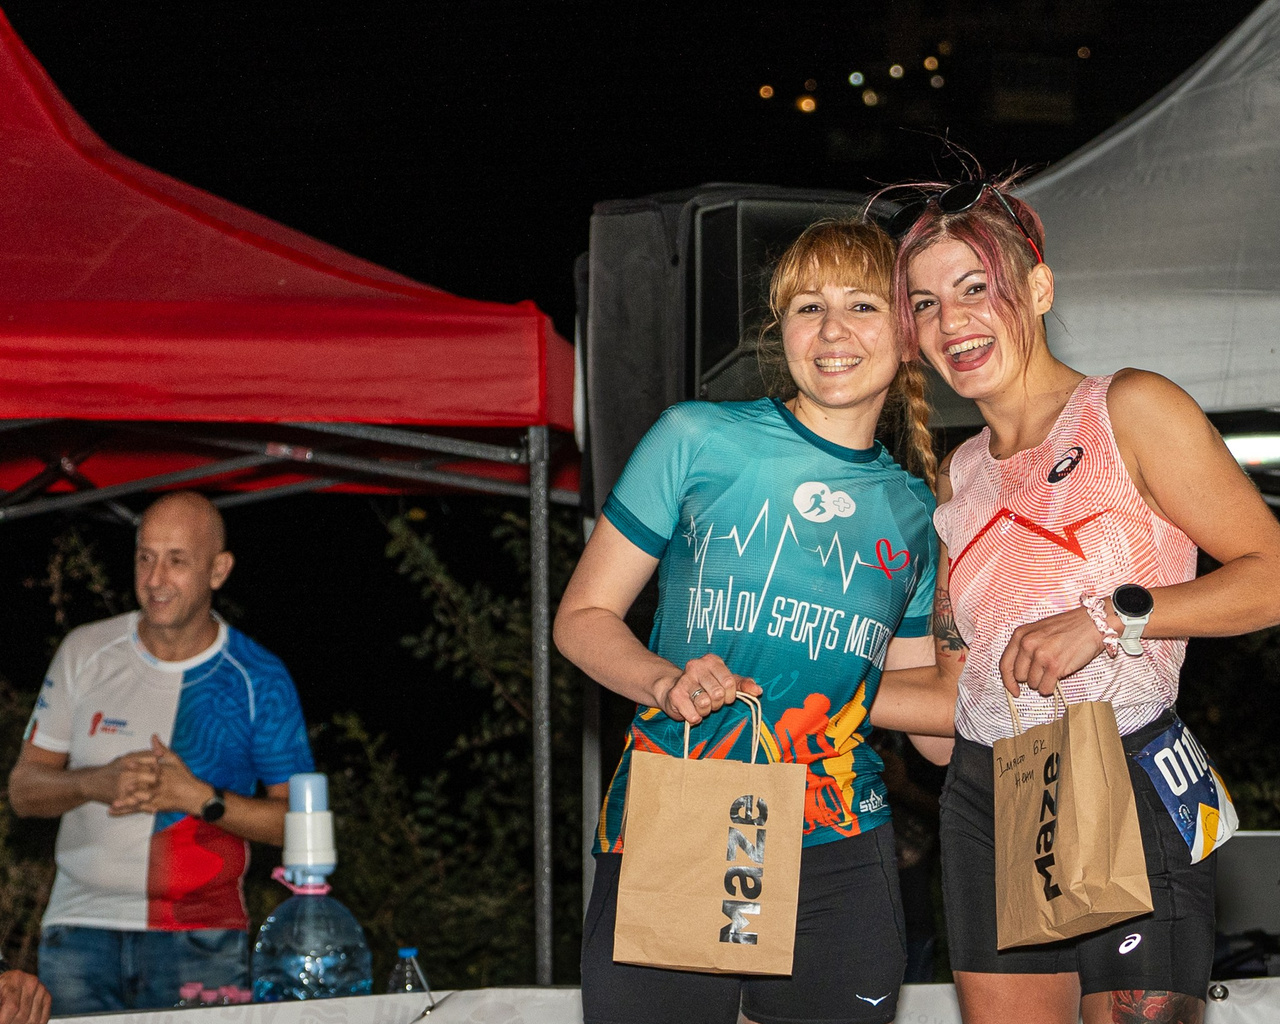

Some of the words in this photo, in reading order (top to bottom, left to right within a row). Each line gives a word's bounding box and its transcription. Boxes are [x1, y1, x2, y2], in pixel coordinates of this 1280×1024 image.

[768, 596, 845, 660] SPORTS
[718, 794, 768, 945] Maze
[1034, 751, 1063, 902] Maze
